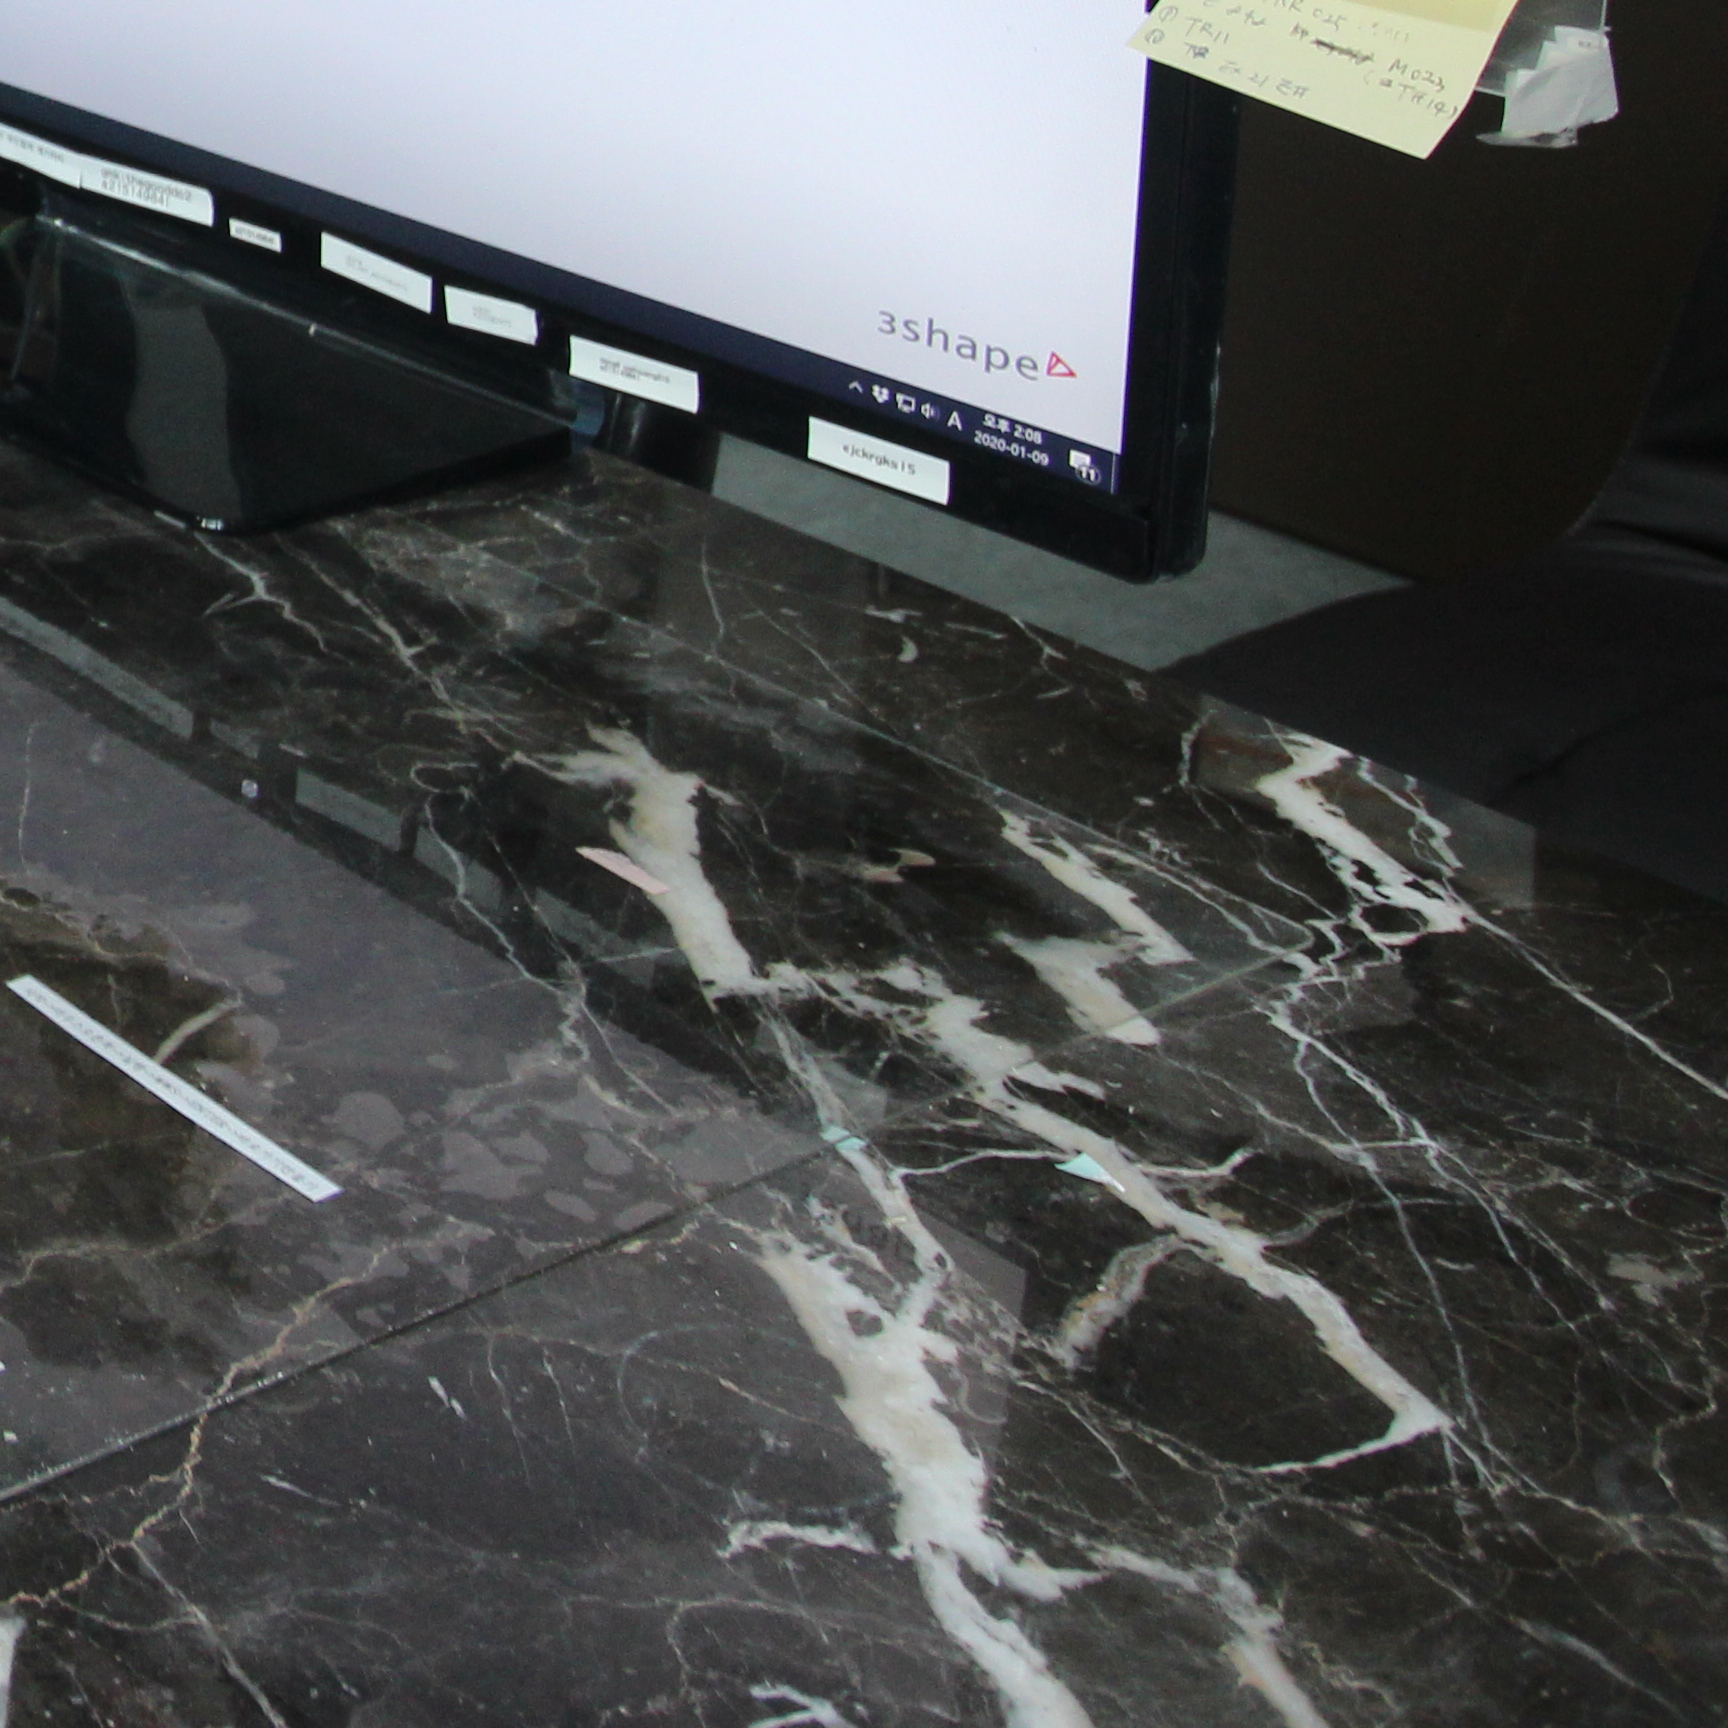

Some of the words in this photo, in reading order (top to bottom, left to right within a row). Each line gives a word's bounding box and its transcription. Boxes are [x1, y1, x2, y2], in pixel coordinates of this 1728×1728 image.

[876, 310, 1040, 382] 3shape
[947, 410, 963, 432] A
[973, 429, 1050, 468] 2020-01-09
